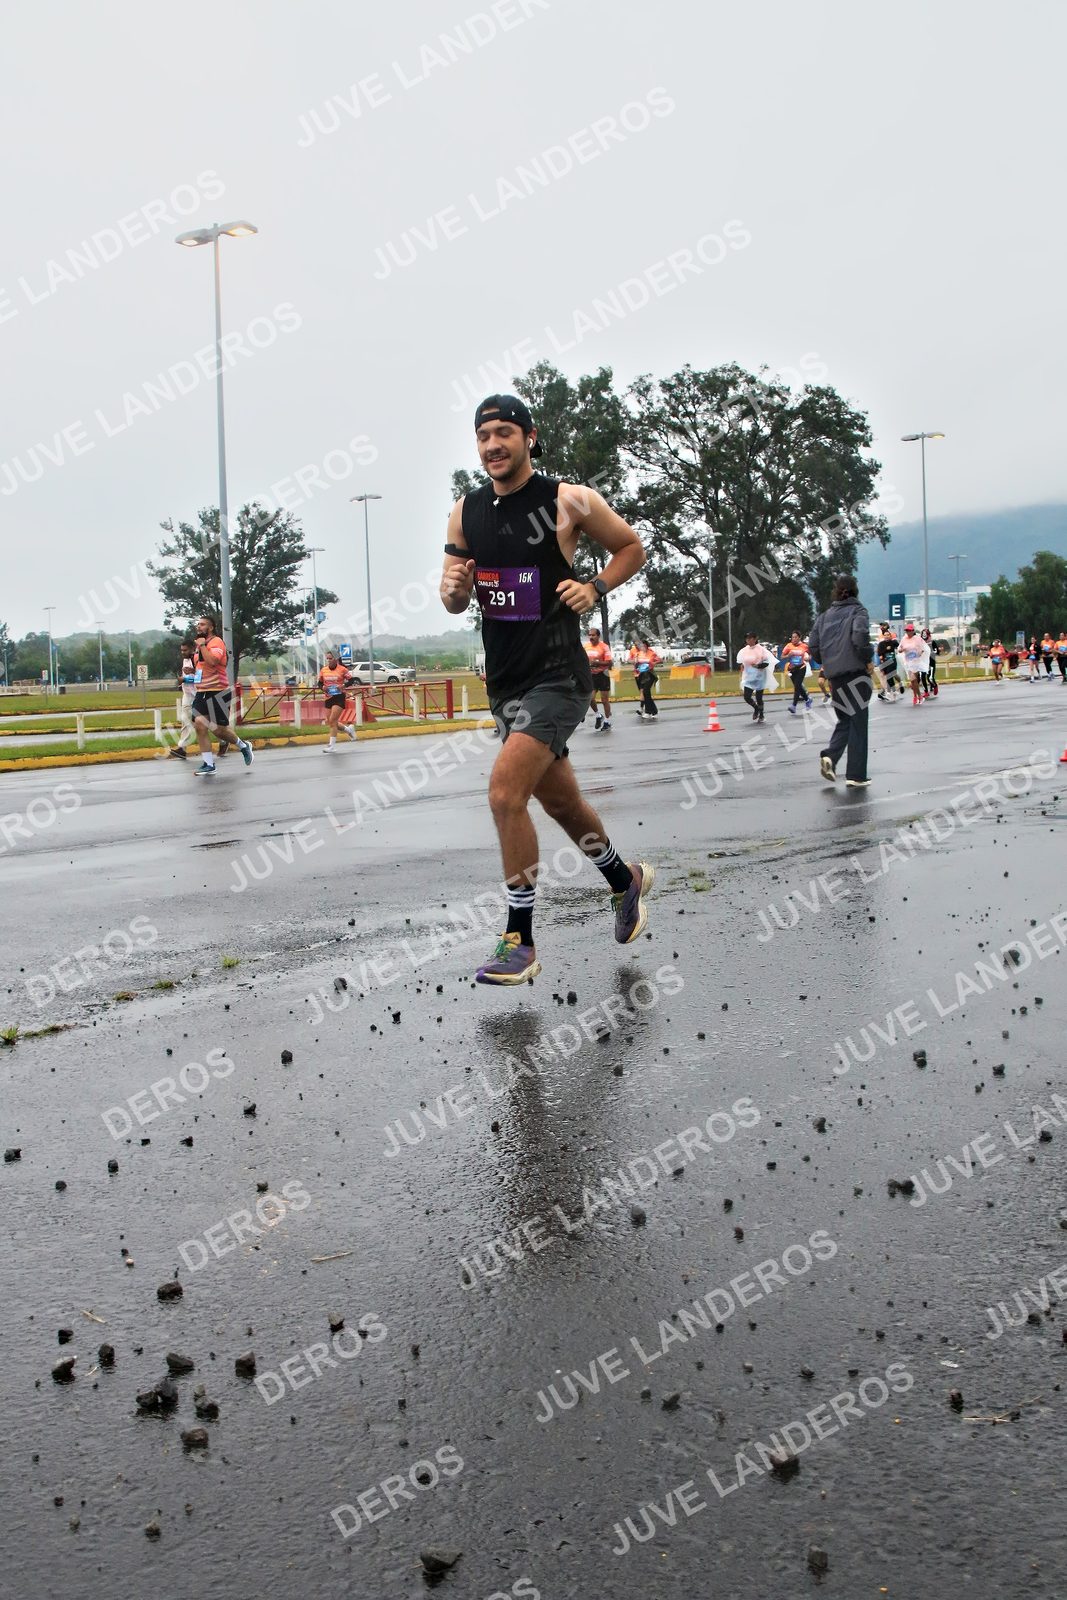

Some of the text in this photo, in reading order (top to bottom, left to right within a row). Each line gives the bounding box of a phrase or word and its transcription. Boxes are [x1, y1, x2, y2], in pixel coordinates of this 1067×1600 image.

[519, 572, 533, 583] 16K
[489, 591, 515, 606] 291
[892, 605, 900, 617] E
